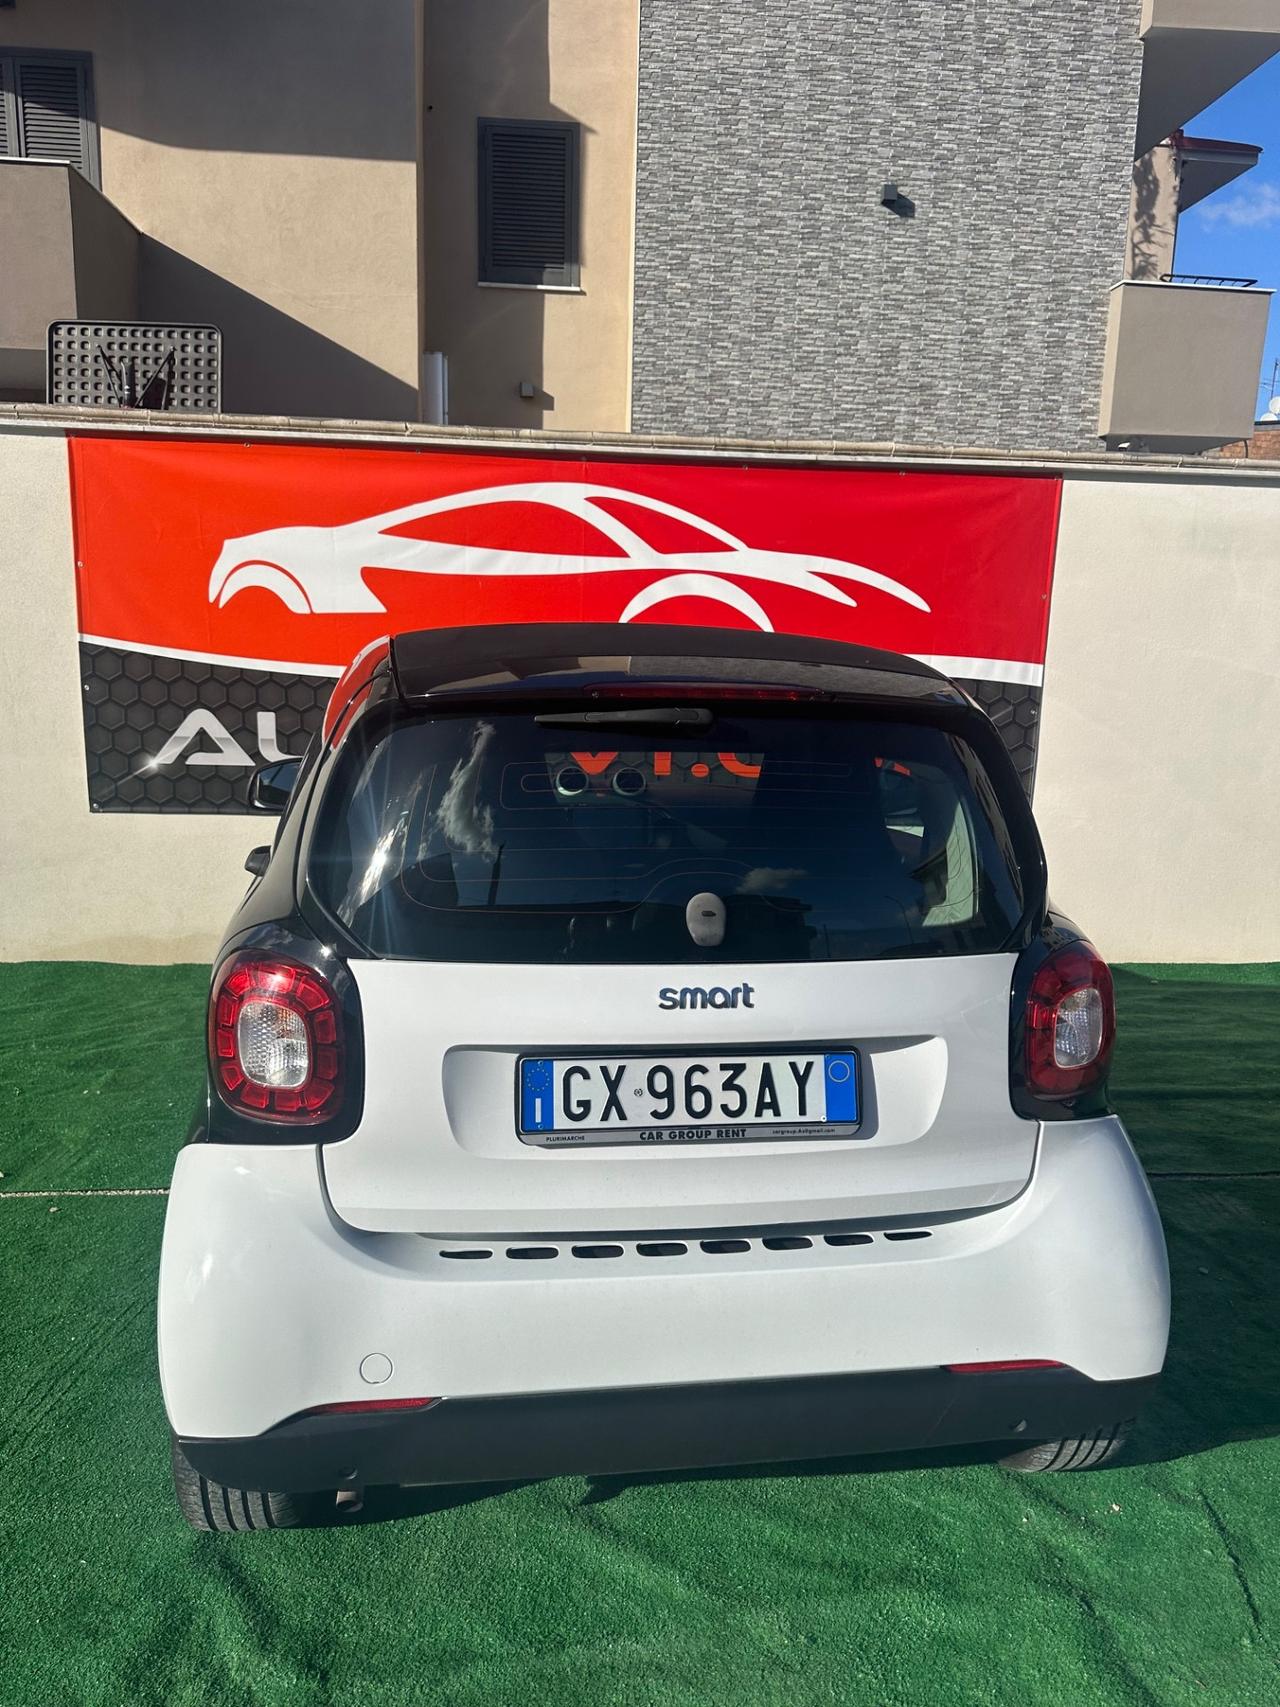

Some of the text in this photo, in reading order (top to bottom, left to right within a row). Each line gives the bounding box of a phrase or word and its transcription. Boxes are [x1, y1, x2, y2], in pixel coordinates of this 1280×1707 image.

[658, 982, 756, 1010] smart
[639, 1128, 747, 1141] CAR GROUP RENT
